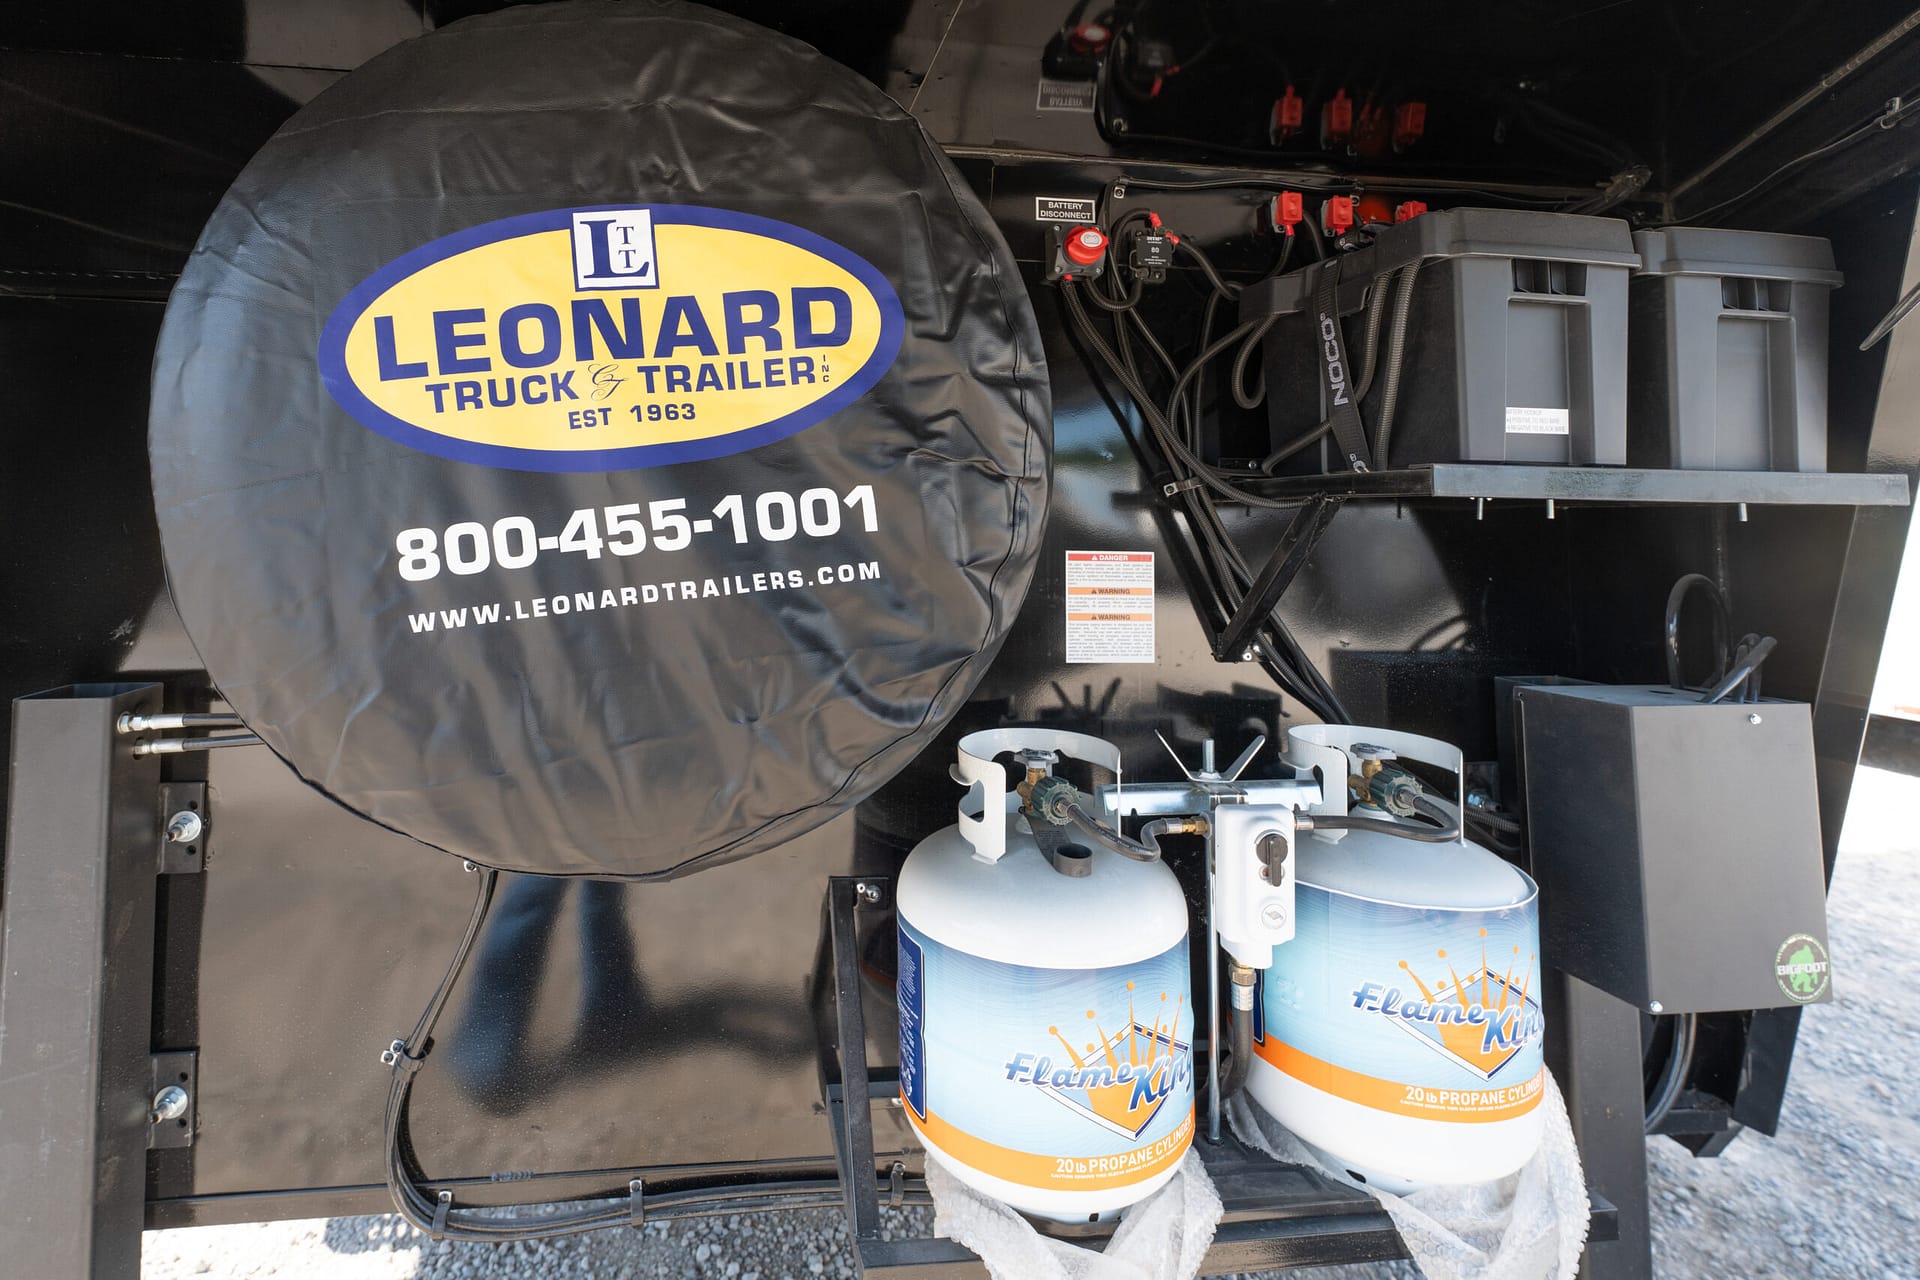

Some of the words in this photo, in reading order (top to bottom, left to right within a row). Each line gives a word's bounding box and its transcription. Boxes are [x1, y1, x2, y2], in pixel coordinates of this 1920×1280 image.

[1040, 210, 1091, 219] DISCONNECT
[1048, 201, 1083, 210] BATTERY
[374, 286, 853, 382] LEONARD
[425, 370, 580, 414] TRUCK
[637, 356, 816, 394] TRAILER
[568, 407, 612, 430] EST
[630, 403, 697, 423] 1963
[396, 485, 880, 582] 800-455-1001
[408, 562, 881, 634] WWW.LEONARDTRAILERS.COM
[1098, 587, 1131, 595] WARNING
[1098, 613, 1131, 621] WARNING
[1777, 961, 1827, 976] BIGFOOT
[1405, 1085, 1424, 1102] 20
[1425, 1092, 1437, 1103] lb
[1439, 1090, 1505, 1106] PROPANE
[1056, 1158, 1074, 1173] 20
[1075, 1161, 1087, 1173] lb
[1089, 1146, 1153, 1173] PROPANE
